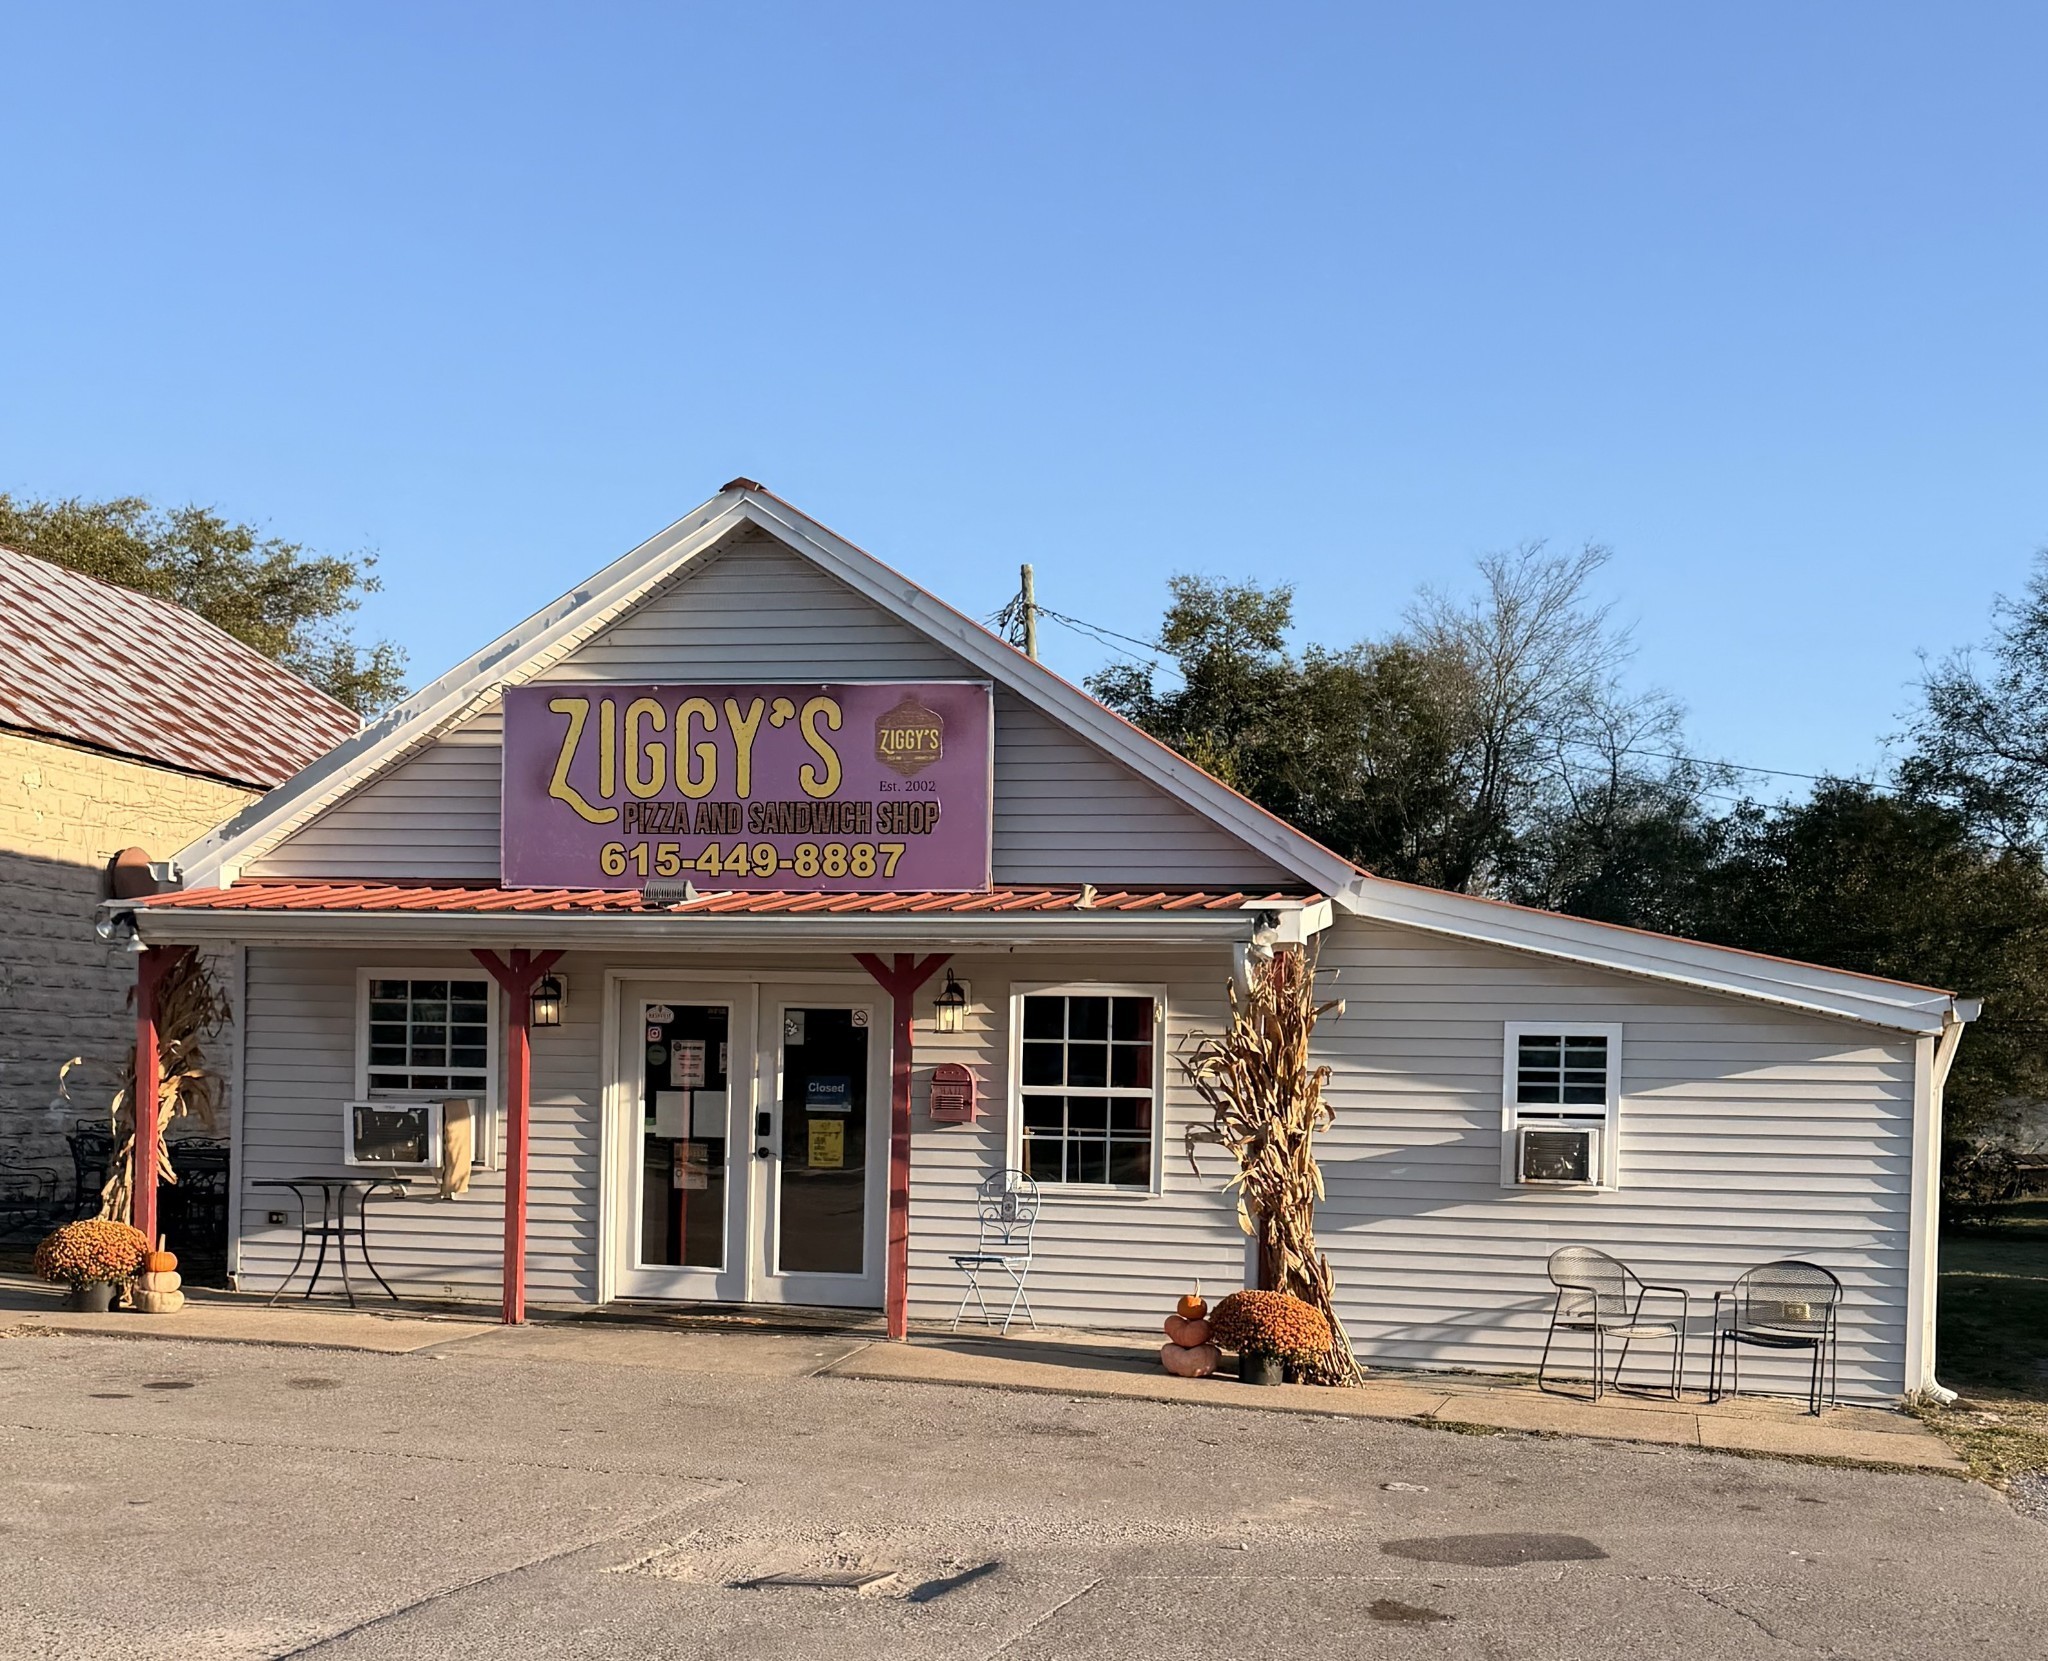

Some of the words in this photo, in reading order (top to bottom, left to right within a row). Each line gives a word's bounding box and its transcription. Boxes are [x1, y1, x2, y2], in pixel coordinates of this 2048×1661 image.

[880, 729, 937, 754] ZIGGY'S
[548, 697, 842, 824] ZIGGY'S
[880, 781, 901, 791] Est.
[906, 781, 936, 791] 2002
[623, 801, 689, 835] PIZZA
[693, 801, 743, 835] AND
[748, 801, 873, 835] SANDWICH
[876, 801, 940, 835] SHOP
[600, 841, 907, 879] 615-449-8887
[808, 1082, 845, 1093] Closed
